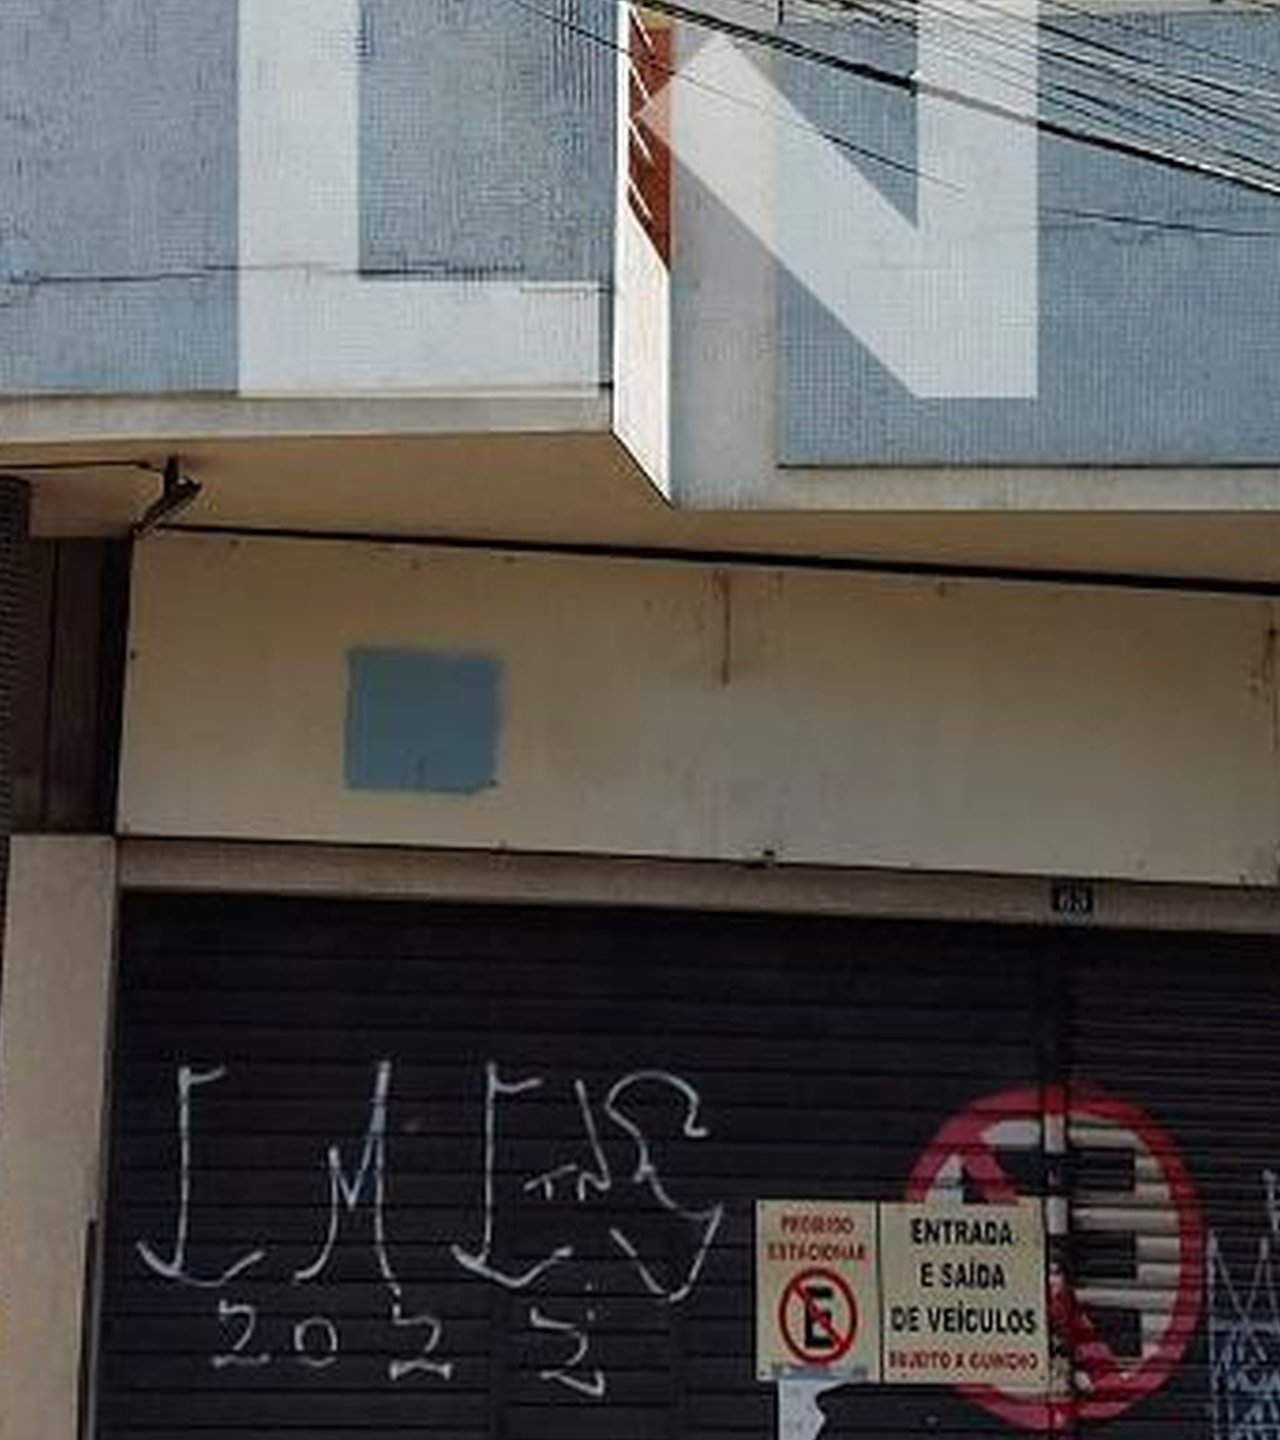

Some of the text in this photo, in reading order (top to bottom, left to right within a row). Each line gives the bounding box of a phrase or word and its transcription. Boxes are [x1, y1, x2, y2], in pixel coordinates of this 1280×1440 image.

[910, 1218, 1014, 1247] ENTRADA
[920, 1261, 1007, 1291] E SAÍDA
[890, 1300, 1037, 1335] DE VEÍCULOS
